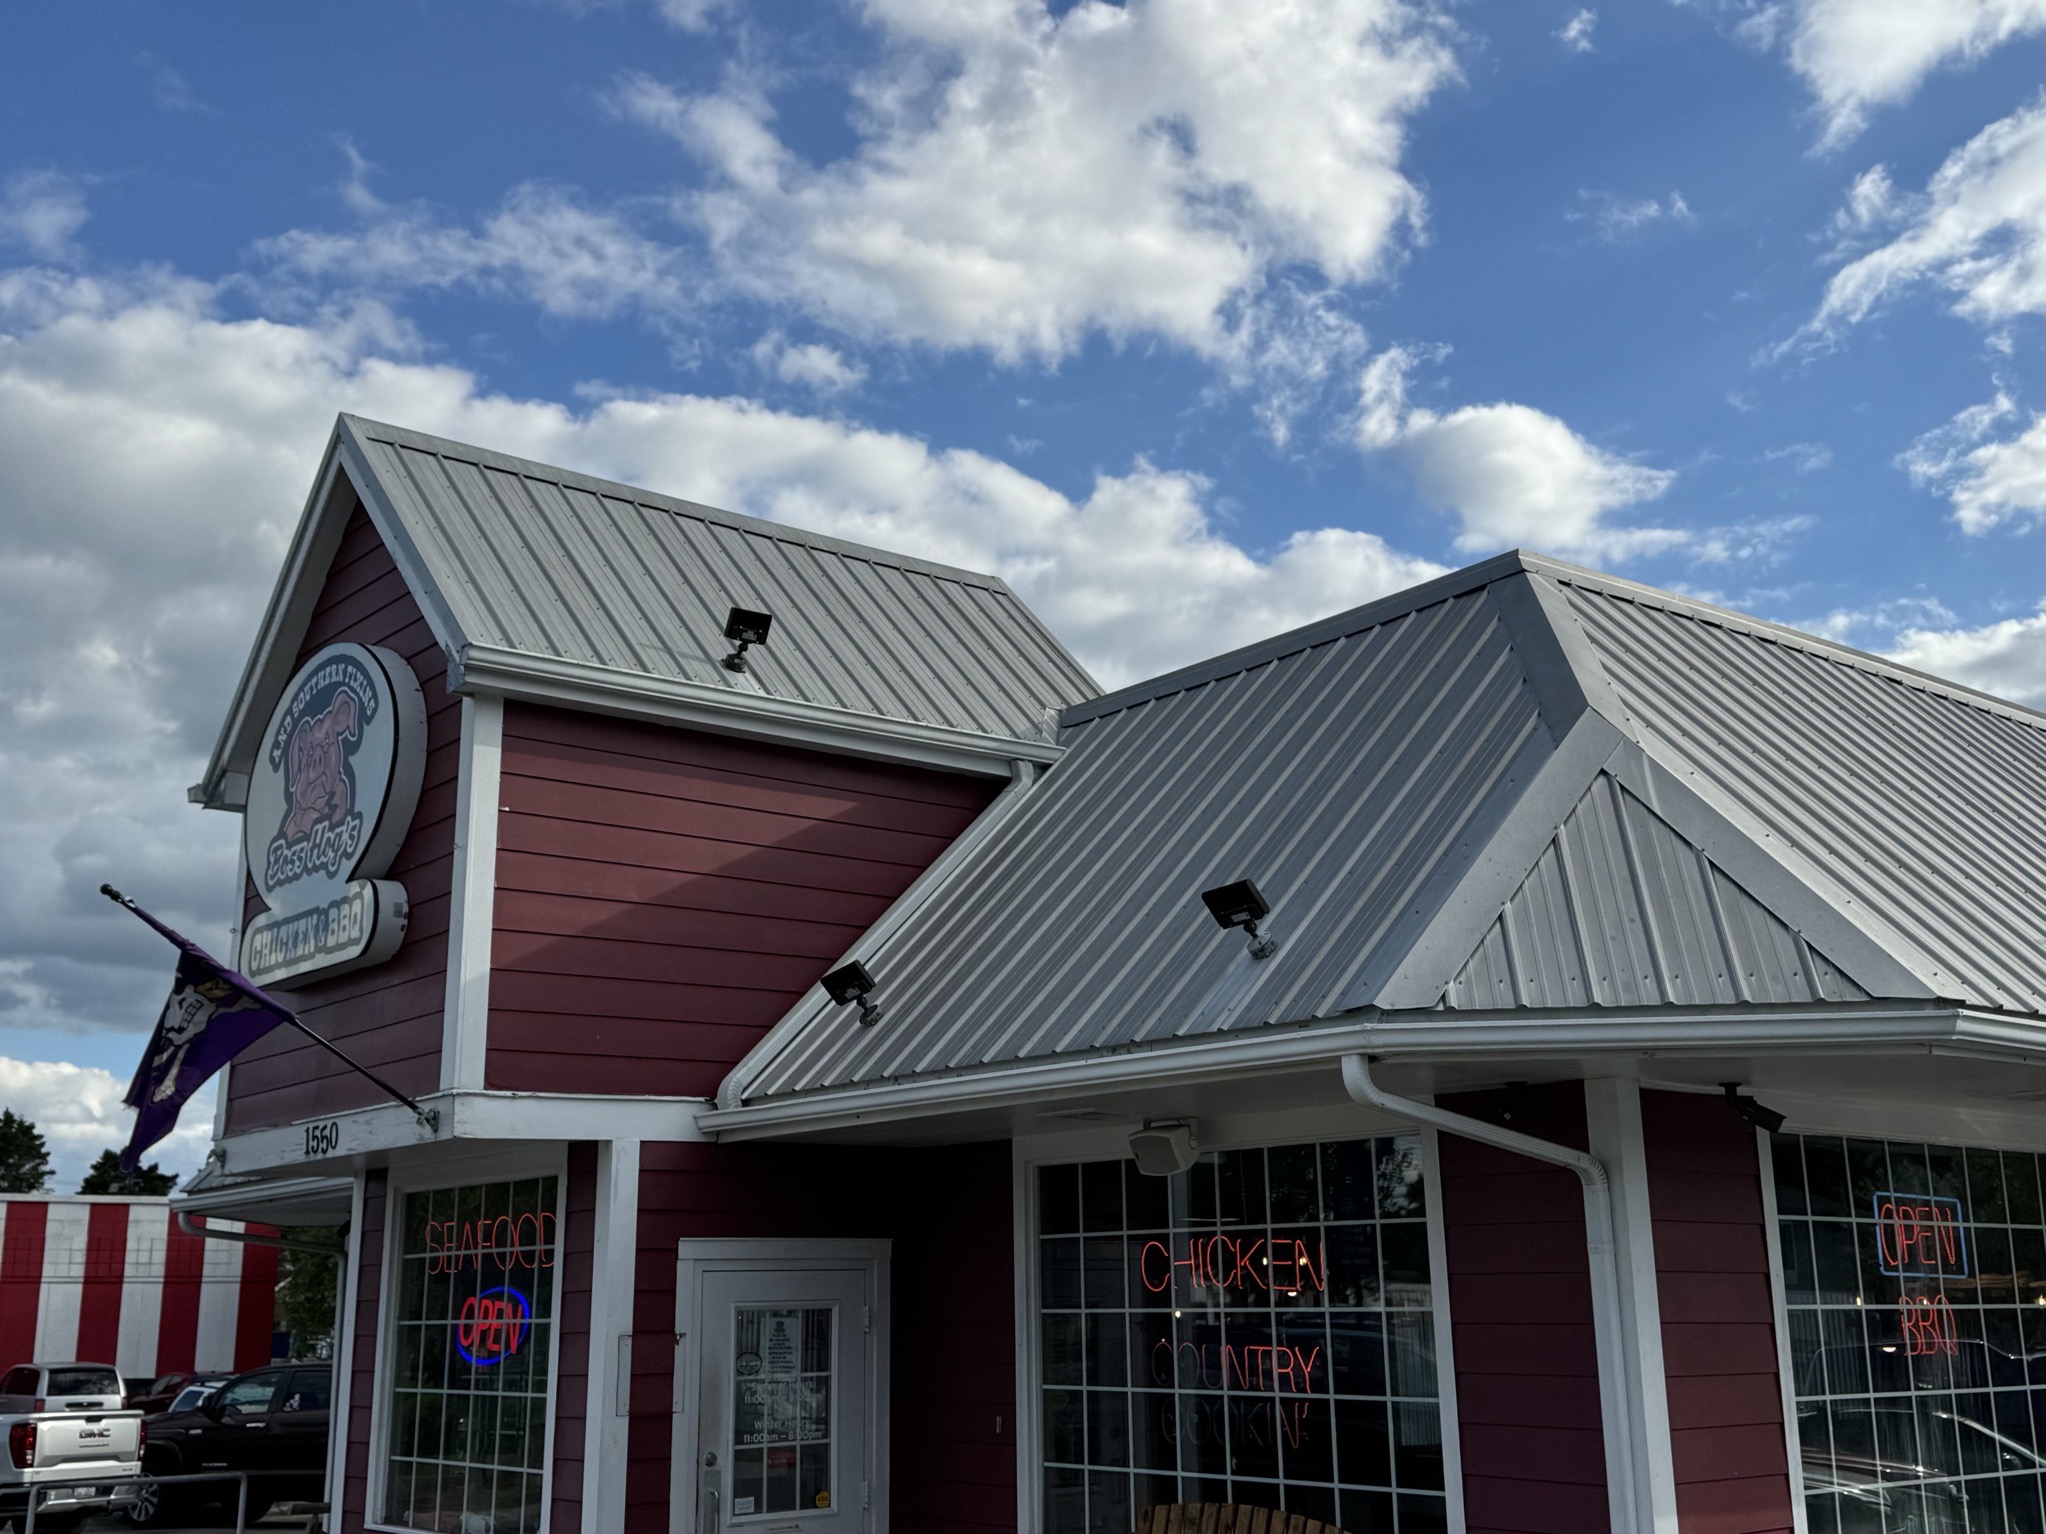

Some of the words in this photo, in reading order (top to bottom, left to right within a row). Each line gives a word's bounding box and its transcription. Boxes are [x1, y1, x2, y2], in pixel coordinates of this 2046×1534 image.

[272, 715, 292, 764] AND
[292, 663, 345, 718] SOUTHERN
[345, 664, 376, 716] FIXINS
[266, 839, 307, 886] Boss
[307, 815, 360, 873] Hog's
[250, 913, 318, 971] CHICKEN
[317, 914, 326, 946] &
[325, 898, 362, 947] BBQ
[304, 1121, 338, 1155] 1550
[424, 1212, 556, 1275] SEAFOOD
[1141, 1235, 1326, 1292] CHICKEN
[1879, 1203, 1956, 1266] OPEN
[458, 1296, 522, 1354] OPEN
[1898, 1294, 1958, 1356] BBQ
[1151, 1341, 1320, 1394] COUNTRY
